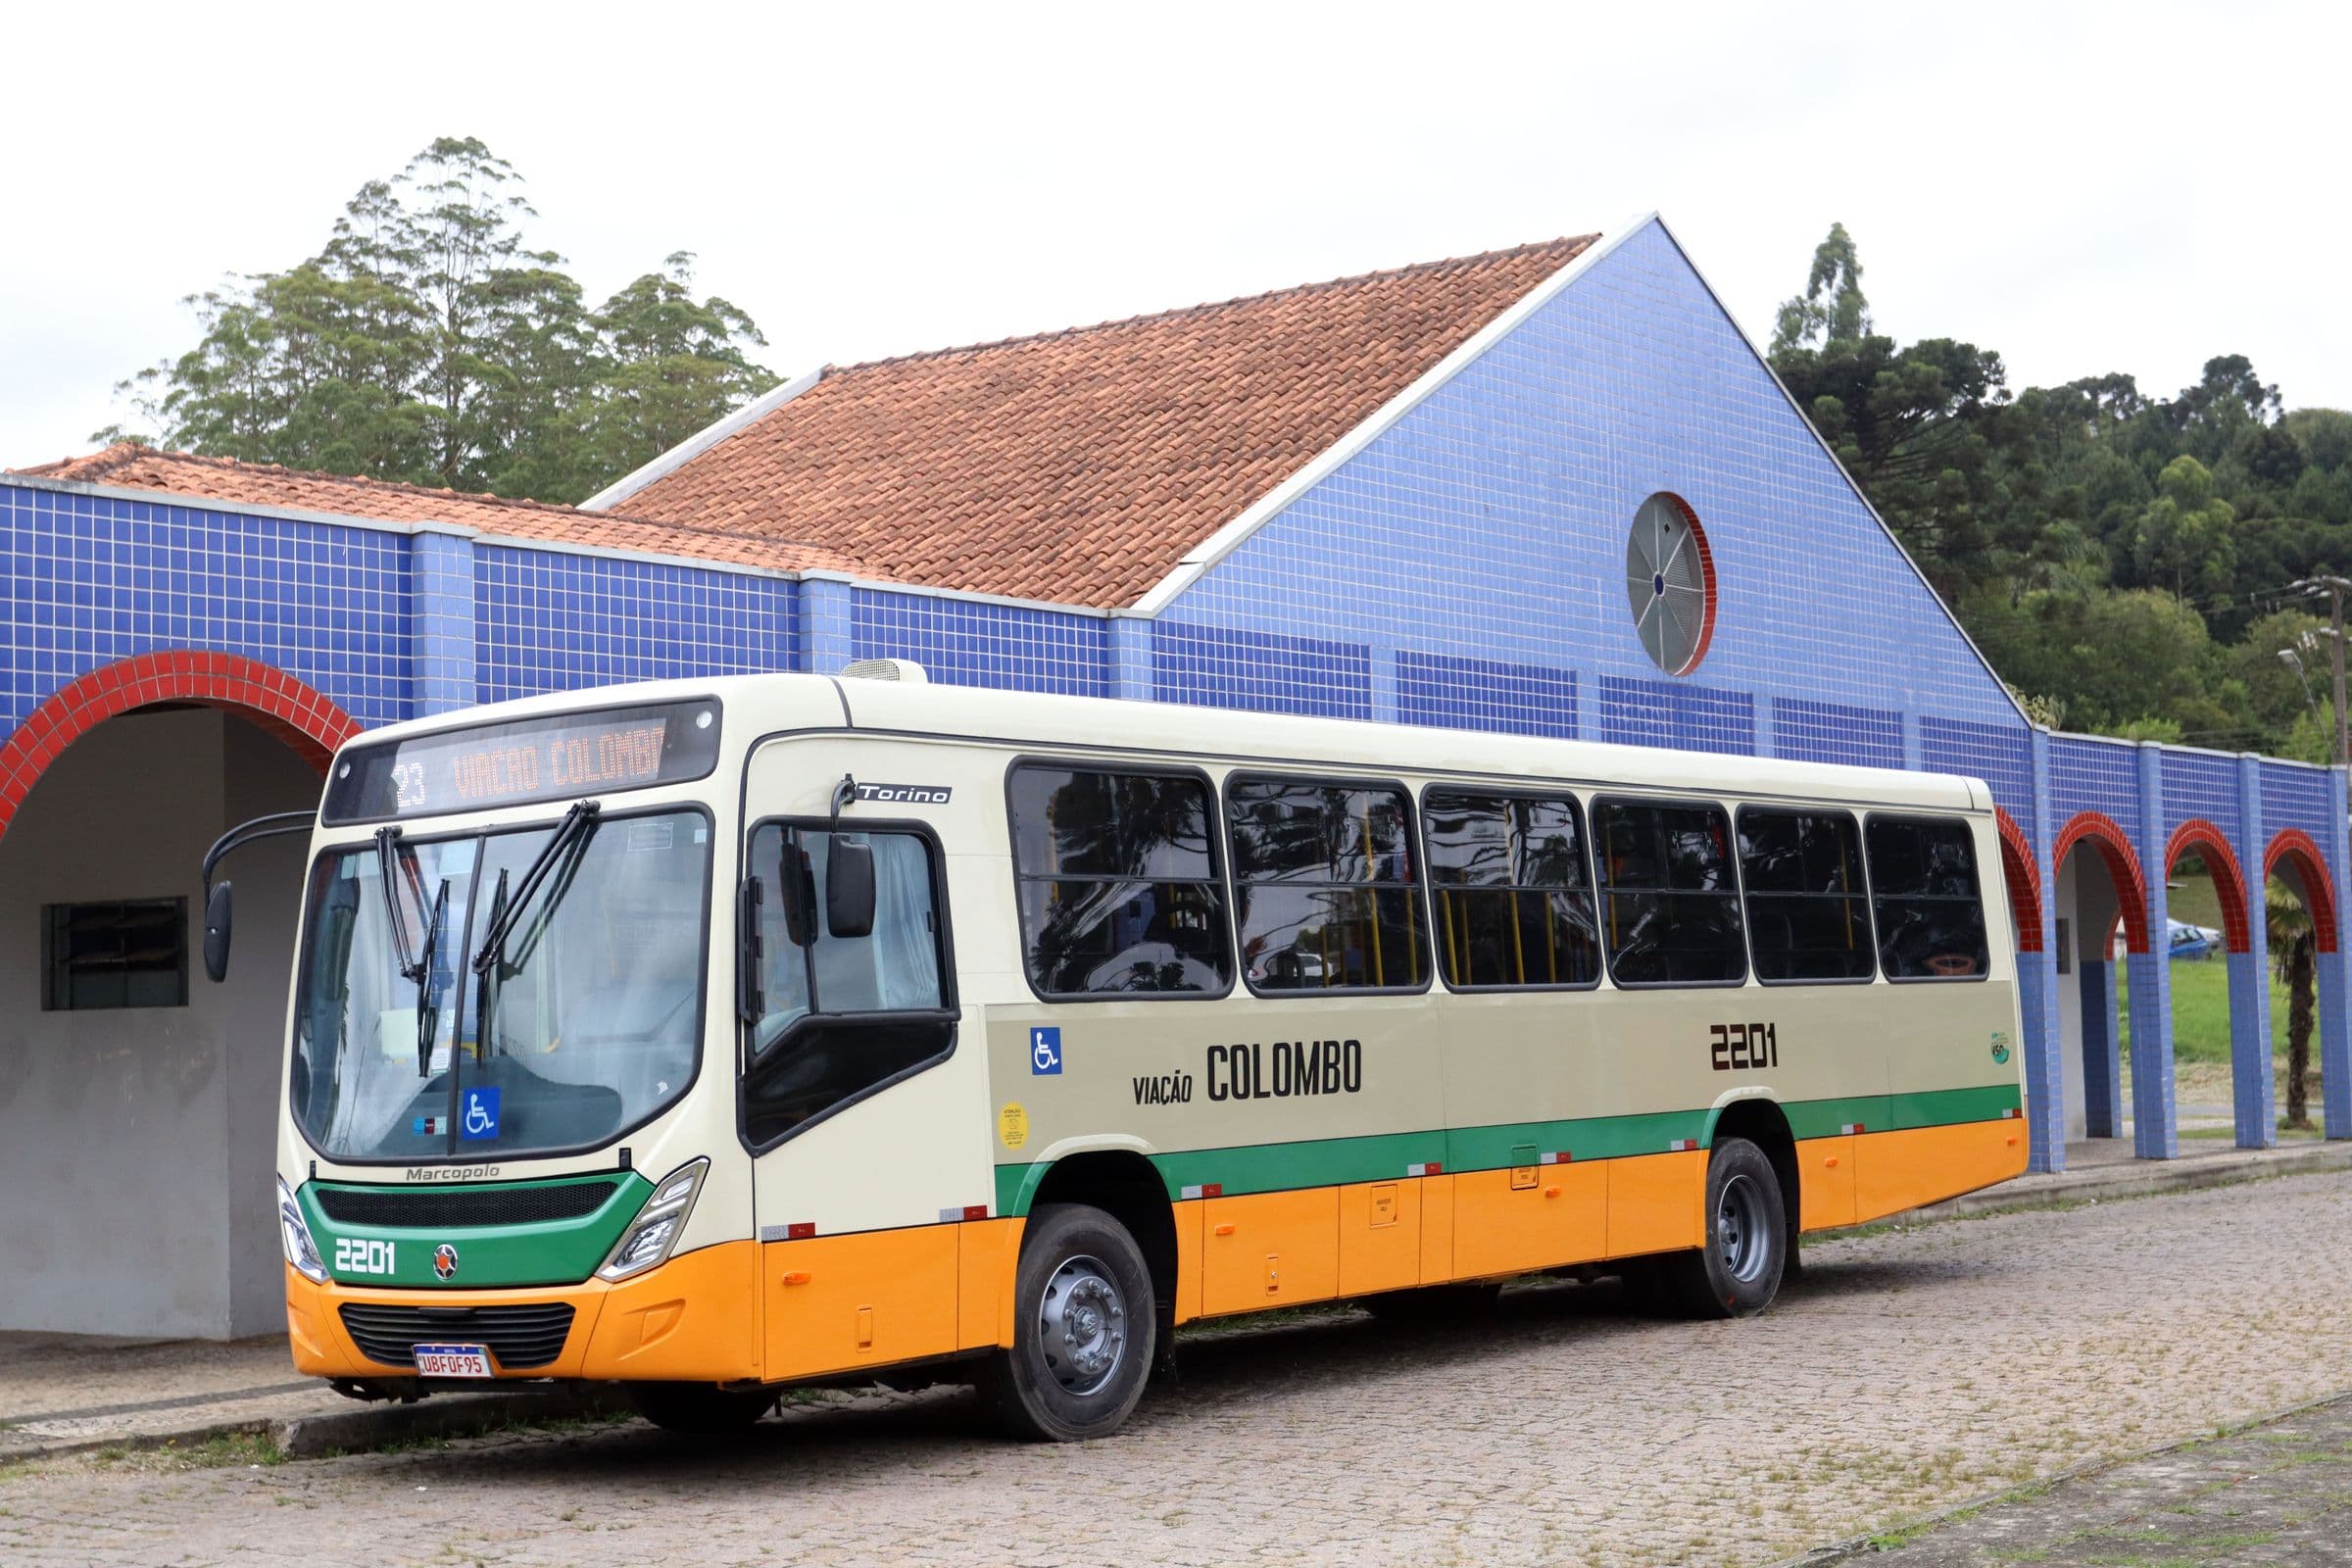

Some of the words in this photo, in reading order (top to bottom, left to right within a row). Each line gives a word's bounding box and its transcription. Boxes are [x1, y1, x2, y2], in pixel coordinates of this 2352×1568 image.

[858, 785, 949, 803] Torino
[1710, 1022, 1778, 1070] 2201
[1206, 1039, 1362, 1102] COLOMBO
[407, 1163, 500, 1181] Marcopolo
[335, 1238, 395, 1275] 2201
